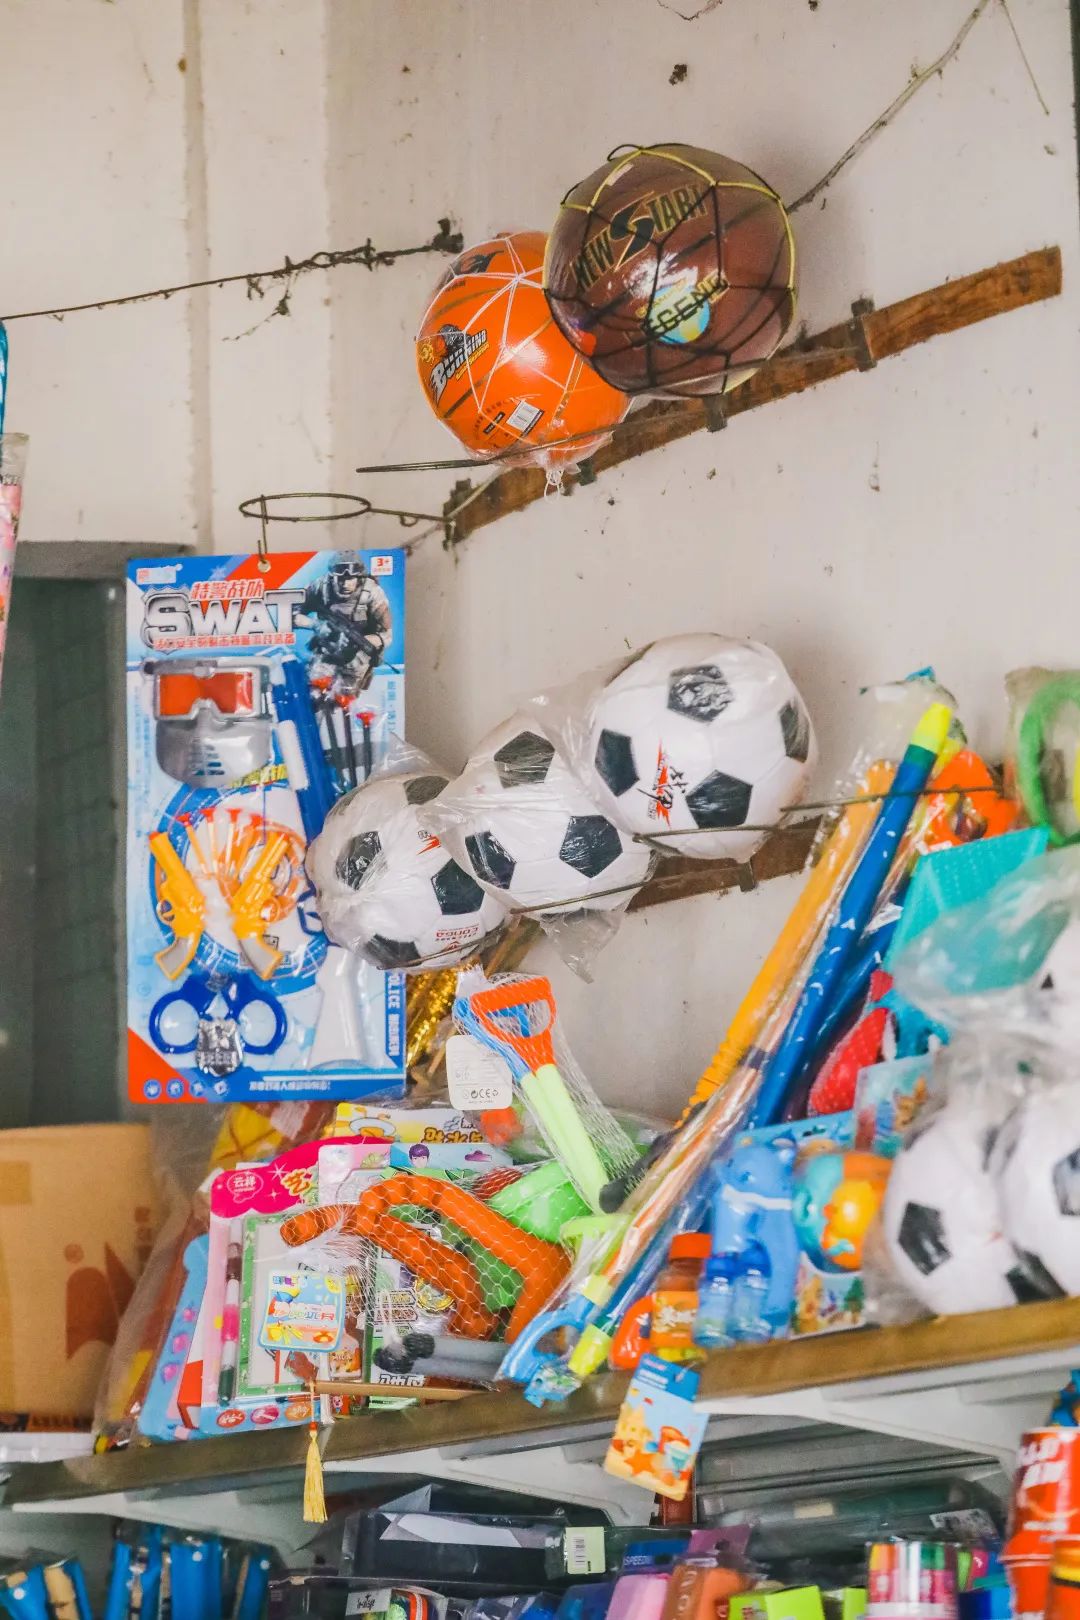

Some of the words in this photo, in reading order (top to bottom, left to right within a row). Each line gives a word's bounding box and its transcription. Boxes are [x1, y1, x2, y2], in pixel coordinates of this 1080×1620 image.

[569, 229, 612, 290] NEW
[607, 184, 708, 272] START
[144, 590, 306, 639] SWAT
